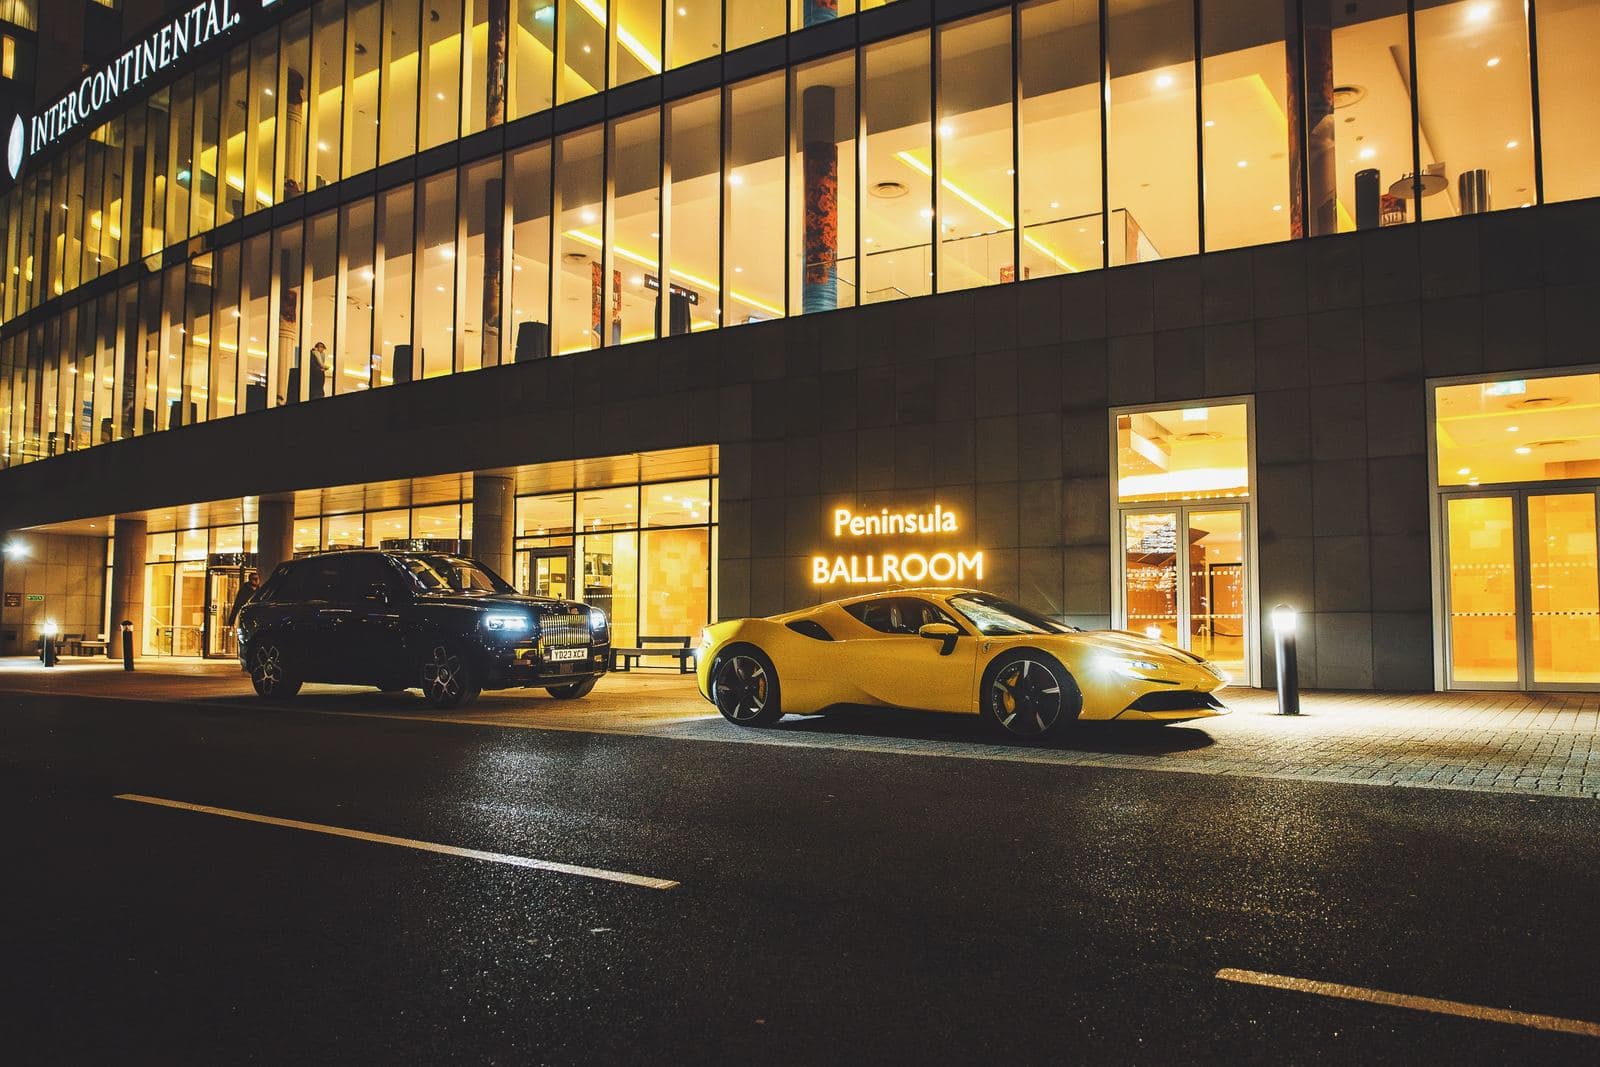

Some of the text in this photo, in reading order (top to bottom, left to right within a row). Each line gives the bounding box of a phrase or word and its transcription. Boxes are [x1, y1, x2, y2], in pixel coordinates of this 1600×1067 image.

[834, 504, 958, 537] Peninsula
[812, 551, 984, 584] BALLROOM
[554, 650, 572, 660] YD23
